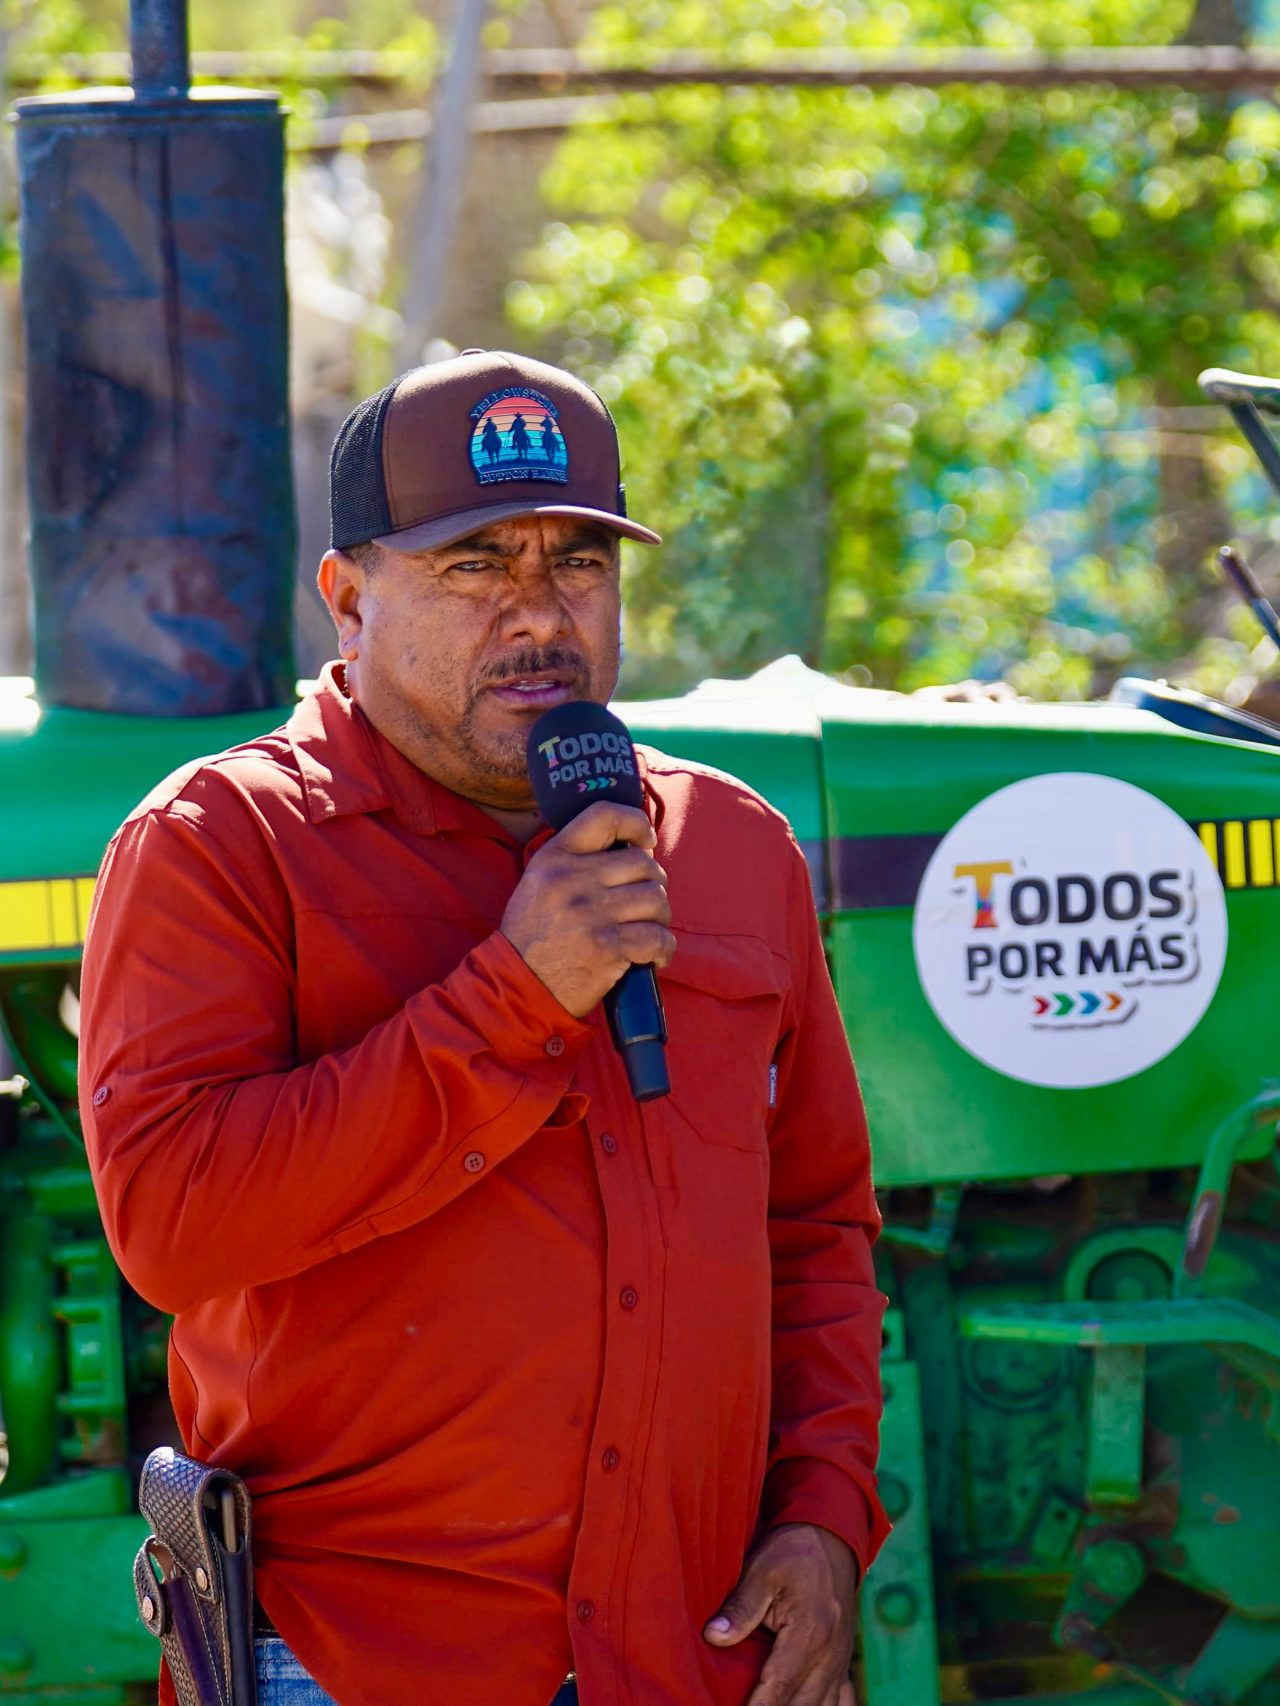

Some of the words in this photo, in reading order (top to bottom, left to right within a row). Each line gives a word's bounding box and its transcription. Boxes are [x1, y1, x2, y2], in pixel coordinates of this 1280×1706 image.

[470, 387, 558, 418] YELLOWSTONE
[480, 470, 528, 483] DUTTON
[538, 732, 630, 768] TODOS
[549, 760, 591, 788] POR
[594, 754, 634, 775] MÁS
[954, 861, 1182, 929] TODOS
[966, 942, 1064, 981] POR
[1079, 926, 1185, 975] MÁS
